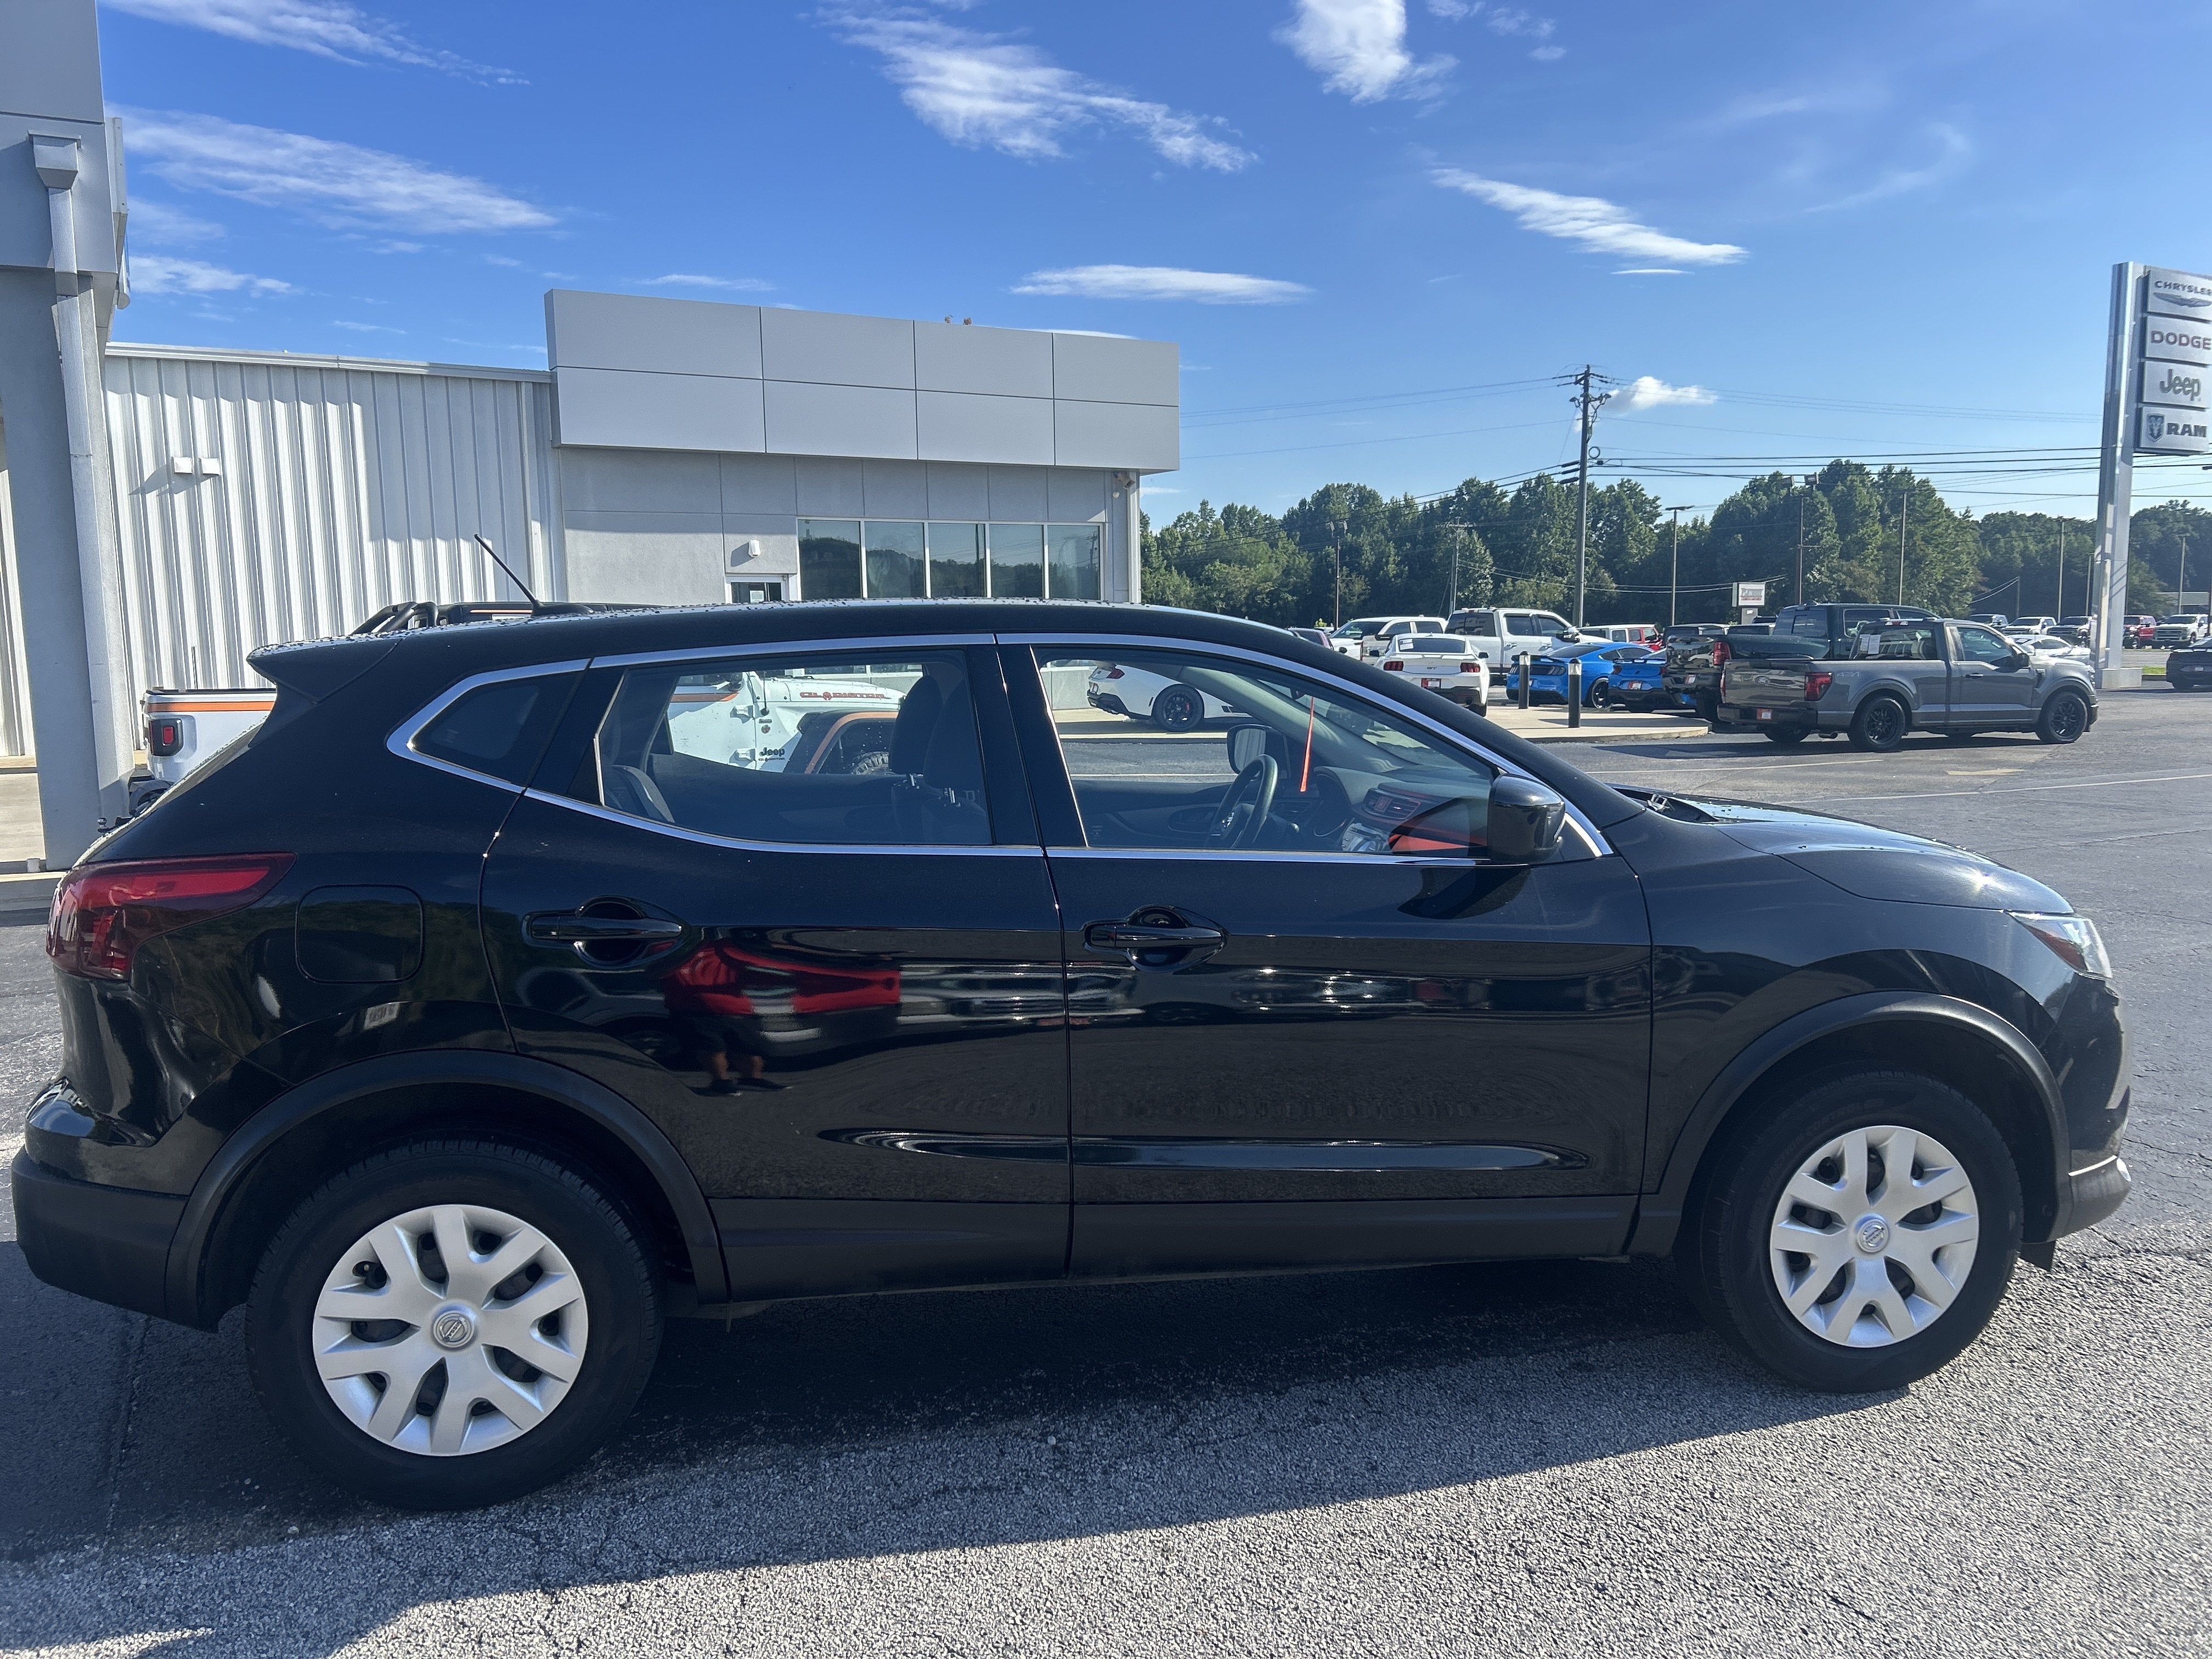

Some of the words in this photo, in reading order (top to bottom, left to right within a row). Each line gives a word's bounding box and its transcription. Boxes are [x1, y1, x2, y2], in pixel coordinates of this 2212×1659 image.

[2151, 330, 2211, 351] DODGE
[2159, 369, 2201, 401] Jeep
[2167, 422, 2207, 438] RAM
[759, 747, 785, 757] Jeep
